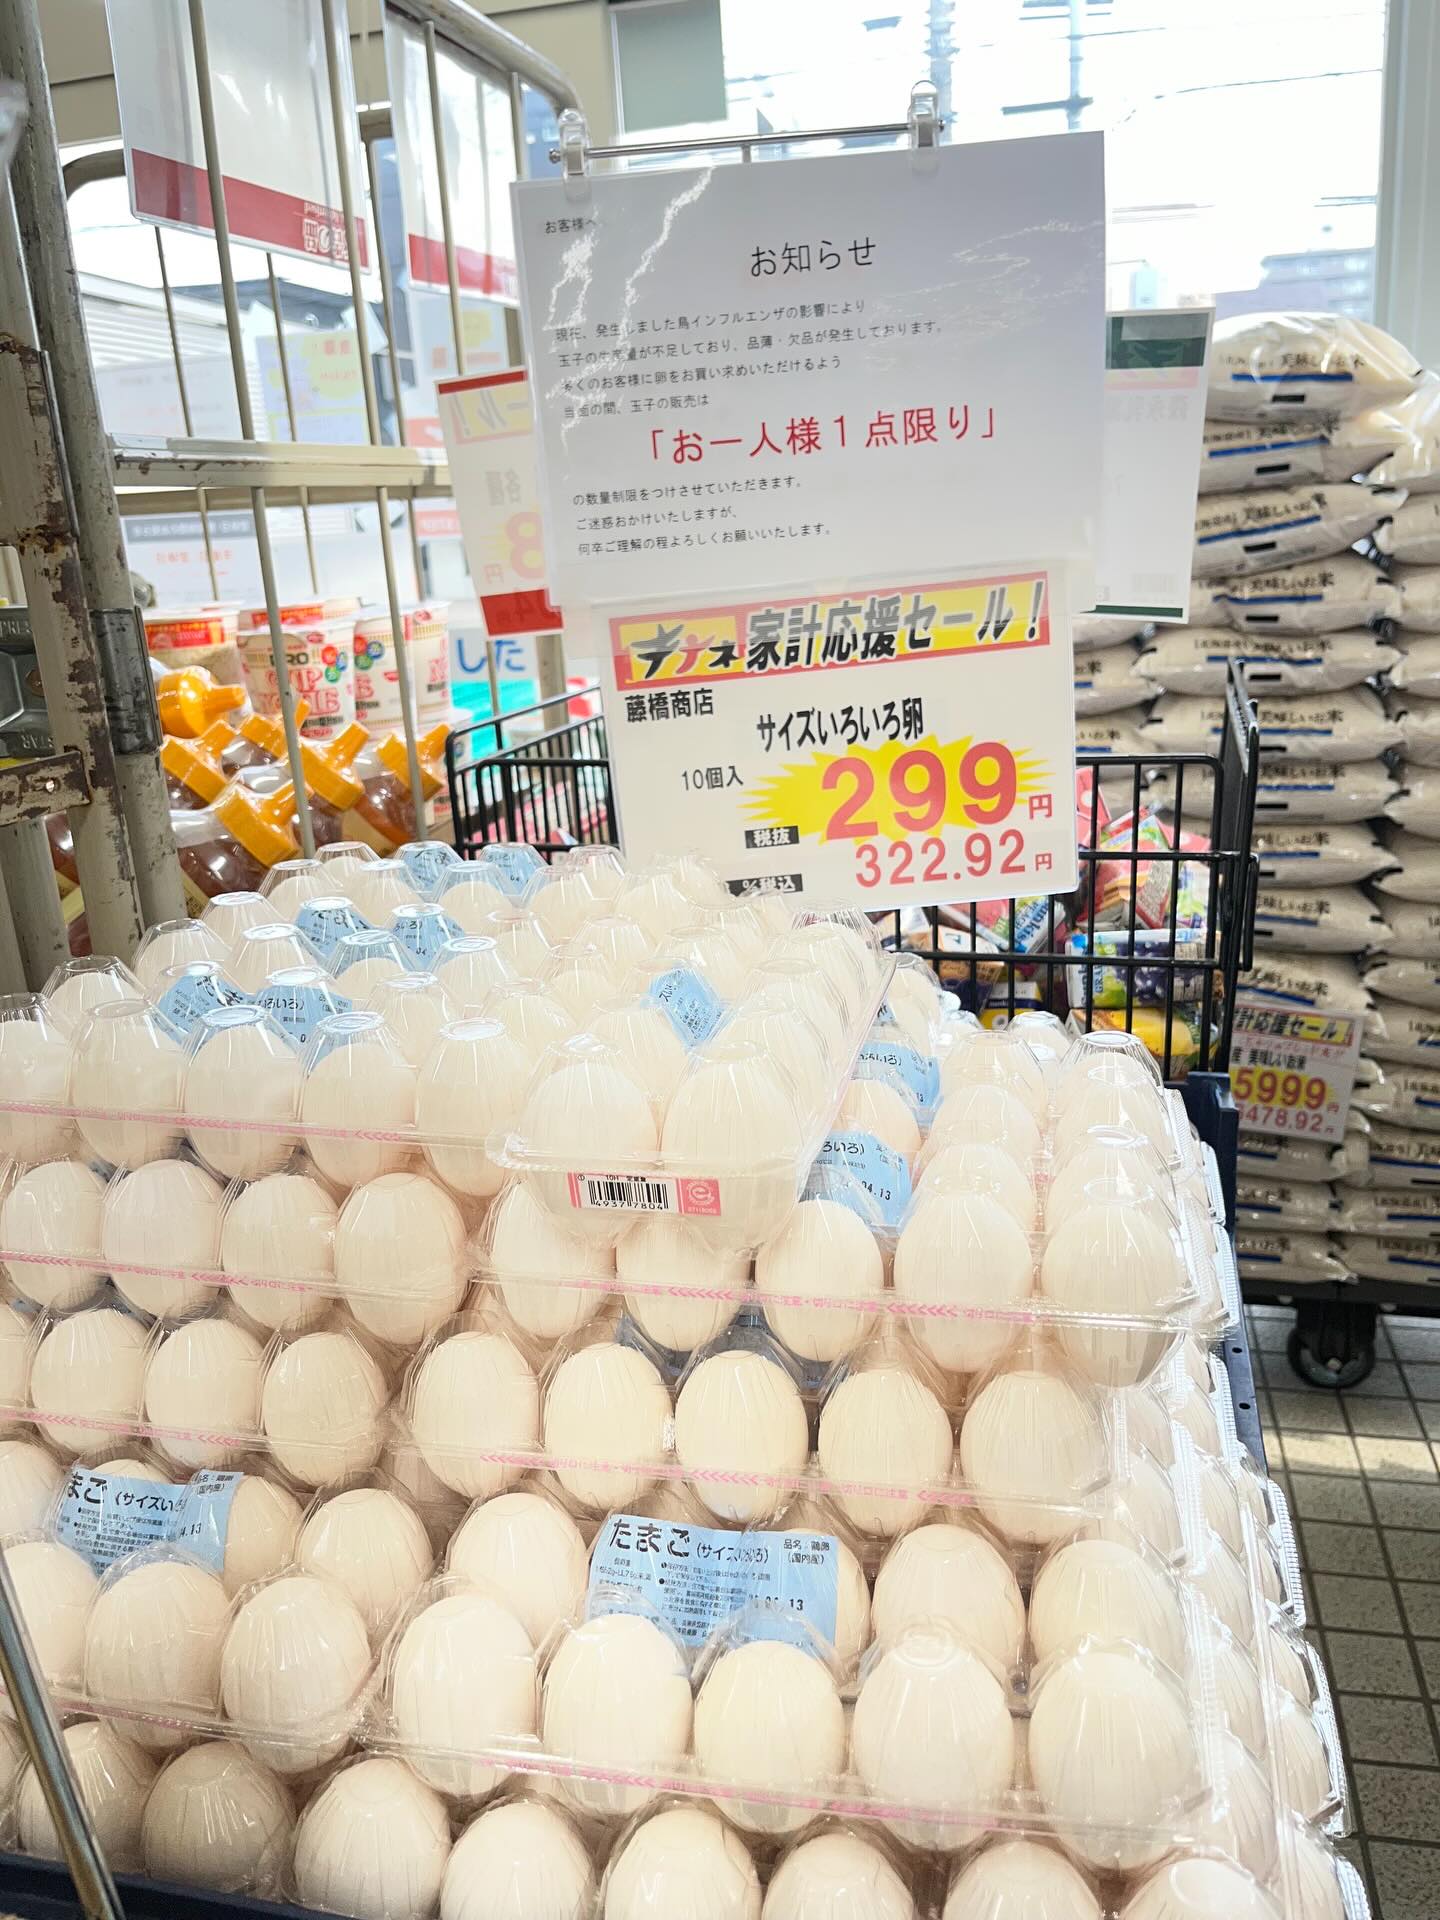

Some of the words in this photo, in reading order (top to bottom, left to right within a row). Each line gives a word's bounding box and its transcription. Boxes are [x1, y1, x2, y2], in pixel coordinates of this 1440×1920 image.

[545, 217, 597, 234] お客様へ
[751, 237, 876, 277] お知らせ
[573, 475, 801, 506] の数量制限をつけさせていただきます。
[576, 506, 738, 531] ご迷惑おかけいたしますが、
[578, 522, 832, 556] 何卒ご理解の程よろしくお願いいたします。
[746, 580, 1045, 672] 家計応援セール!
[625, 688, 715, 724] 藤橋商店
[756, 697, 925, 753] サイズいろいろ卵
[681, 764, 744, 791] 10個入
[820, 741, 1018, 841] 299
[1028, 793, 1054, 821] 円
[752, 827, 791, 848] 税抜
[855, 828, 1027, 890] 322.92
[1035, 852, 1054, 872] 円
[1231, 1066, 1327, 1111] 5999
[608, 1517, 692, 1559] たまご
